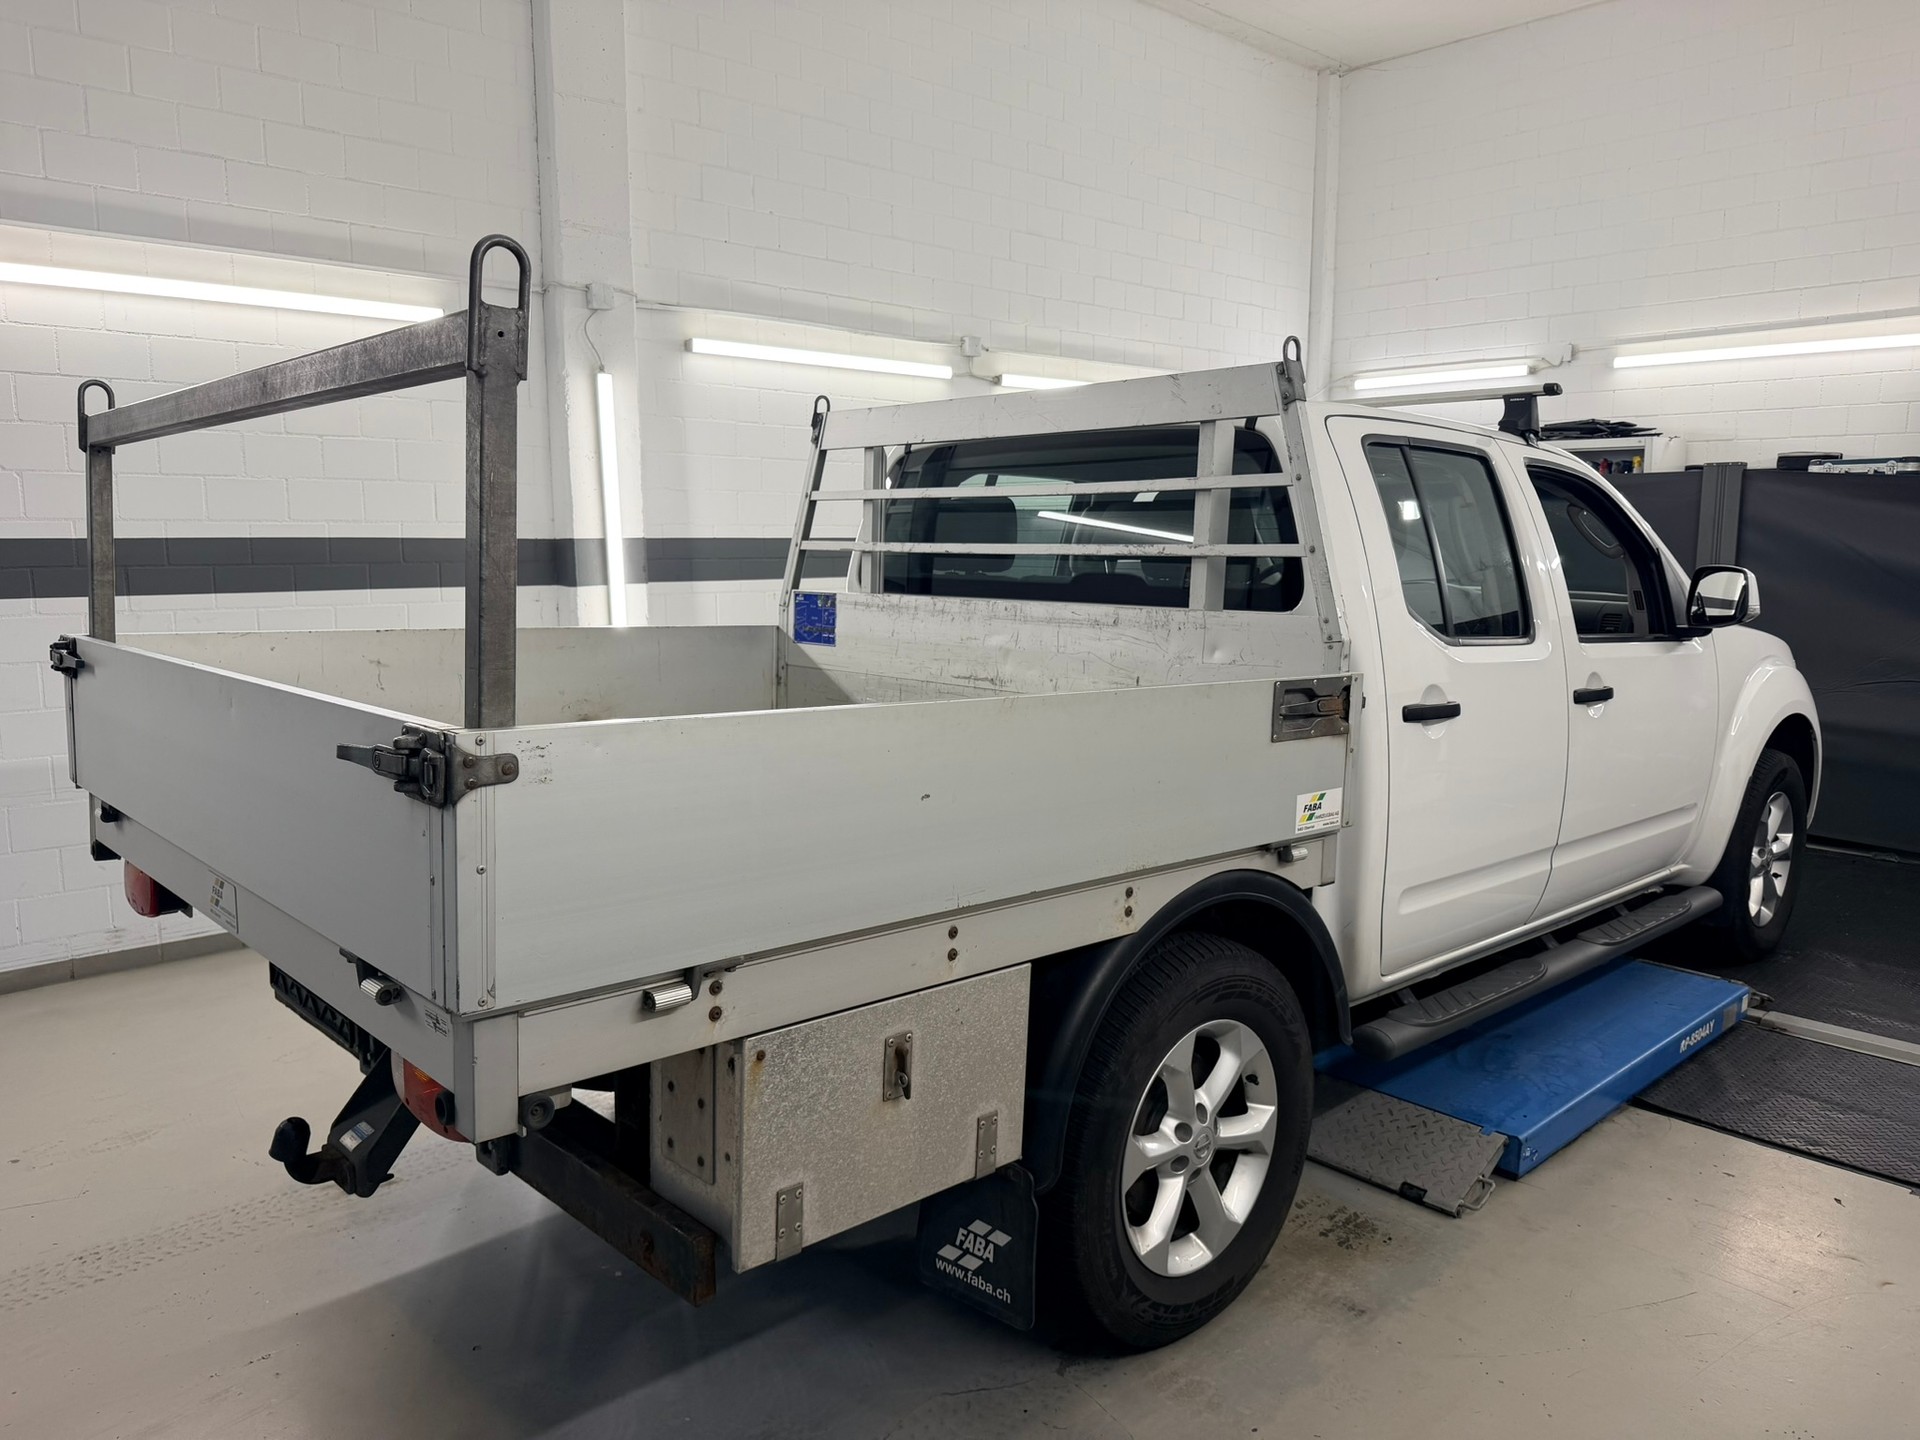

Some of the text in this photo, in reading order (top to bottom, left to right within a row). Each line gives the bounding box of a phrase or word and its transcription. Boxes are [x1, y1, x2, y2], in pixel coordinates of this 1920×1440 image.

[1303, 802, 1322, 813] FABA
[955, 1227, 995, 1263] FABA
[935, 1257, 1011, 1304] www.faba.ch
